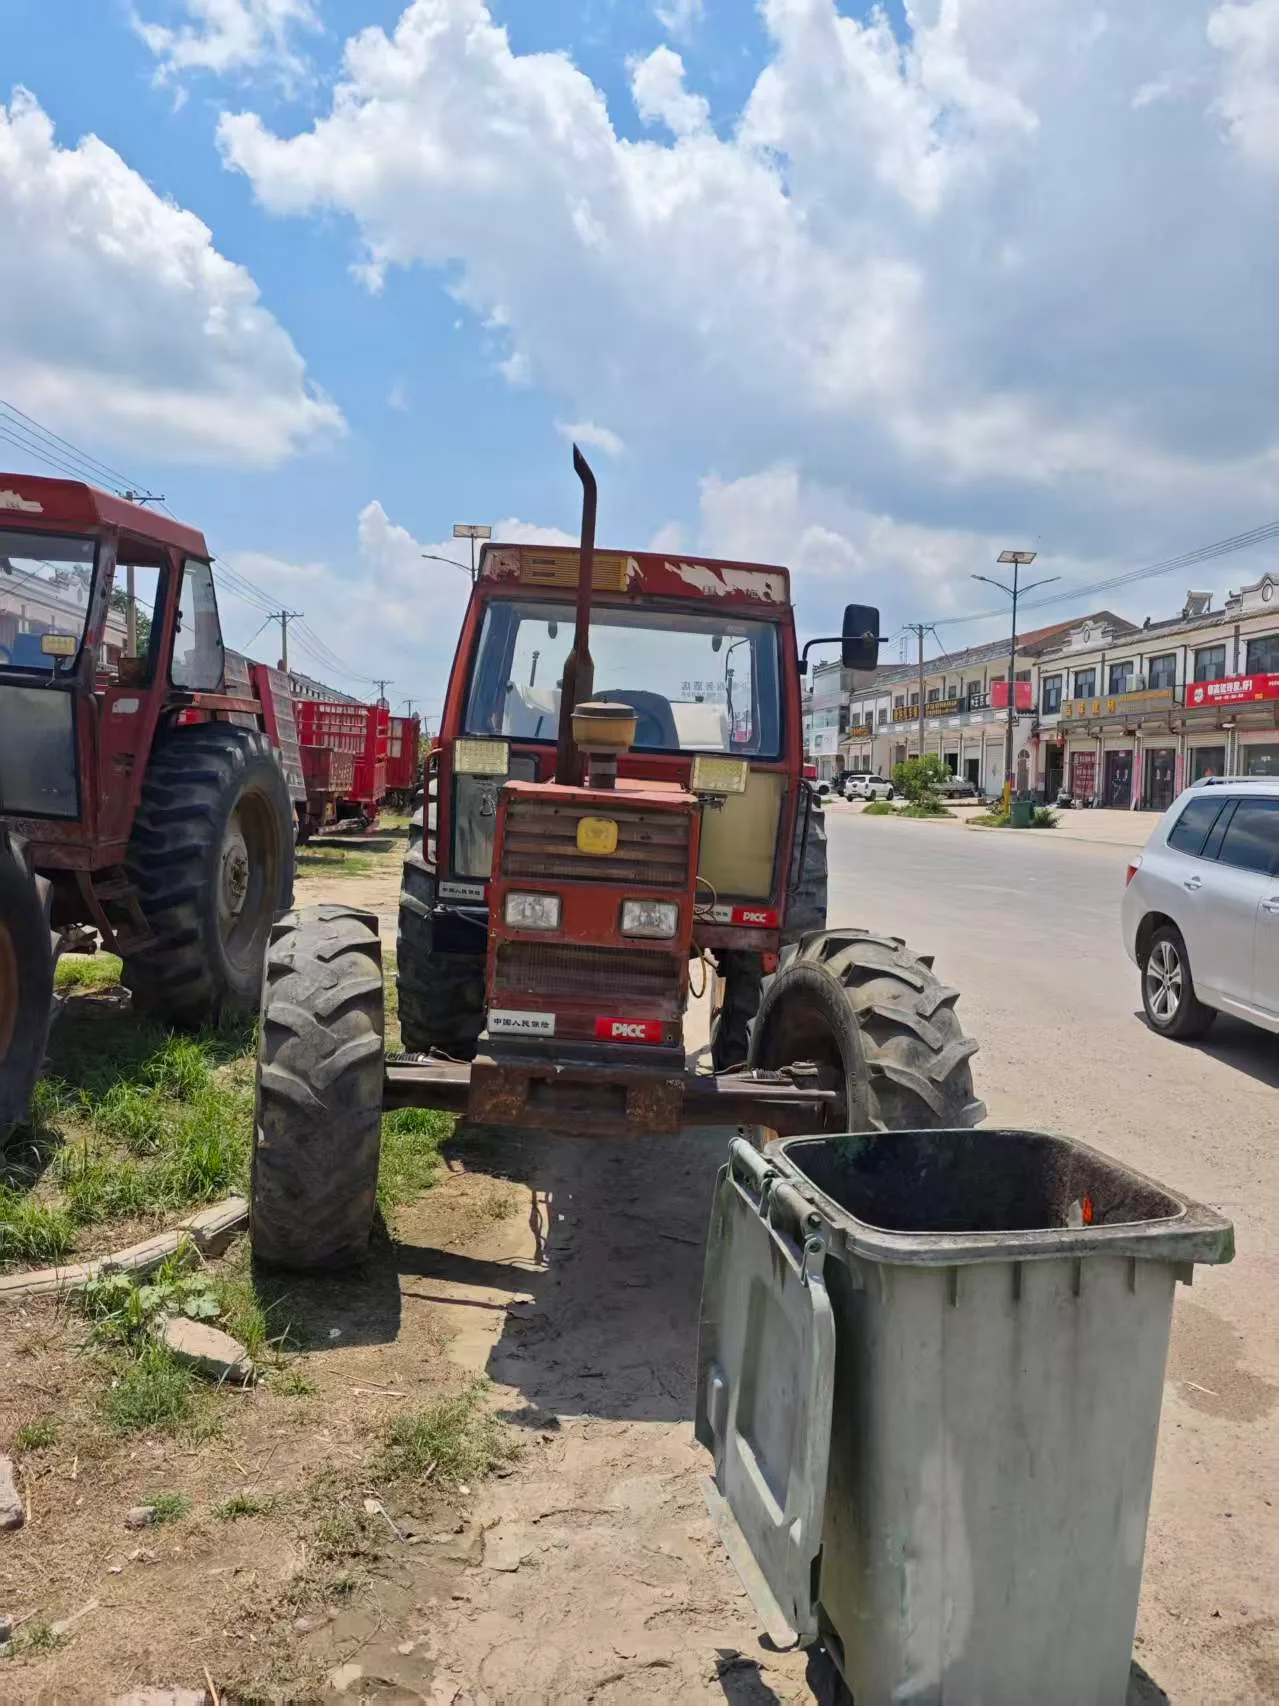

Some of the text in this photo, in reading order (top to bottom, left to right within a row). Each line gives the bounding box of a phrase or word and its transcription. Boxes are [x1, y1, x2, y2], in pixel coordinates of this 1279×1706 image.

[743, 911, 767, 922] PICC
[493, 1018, 550, 1029] 中国人民保险
[612, 1022, 646, 1038] PICC
